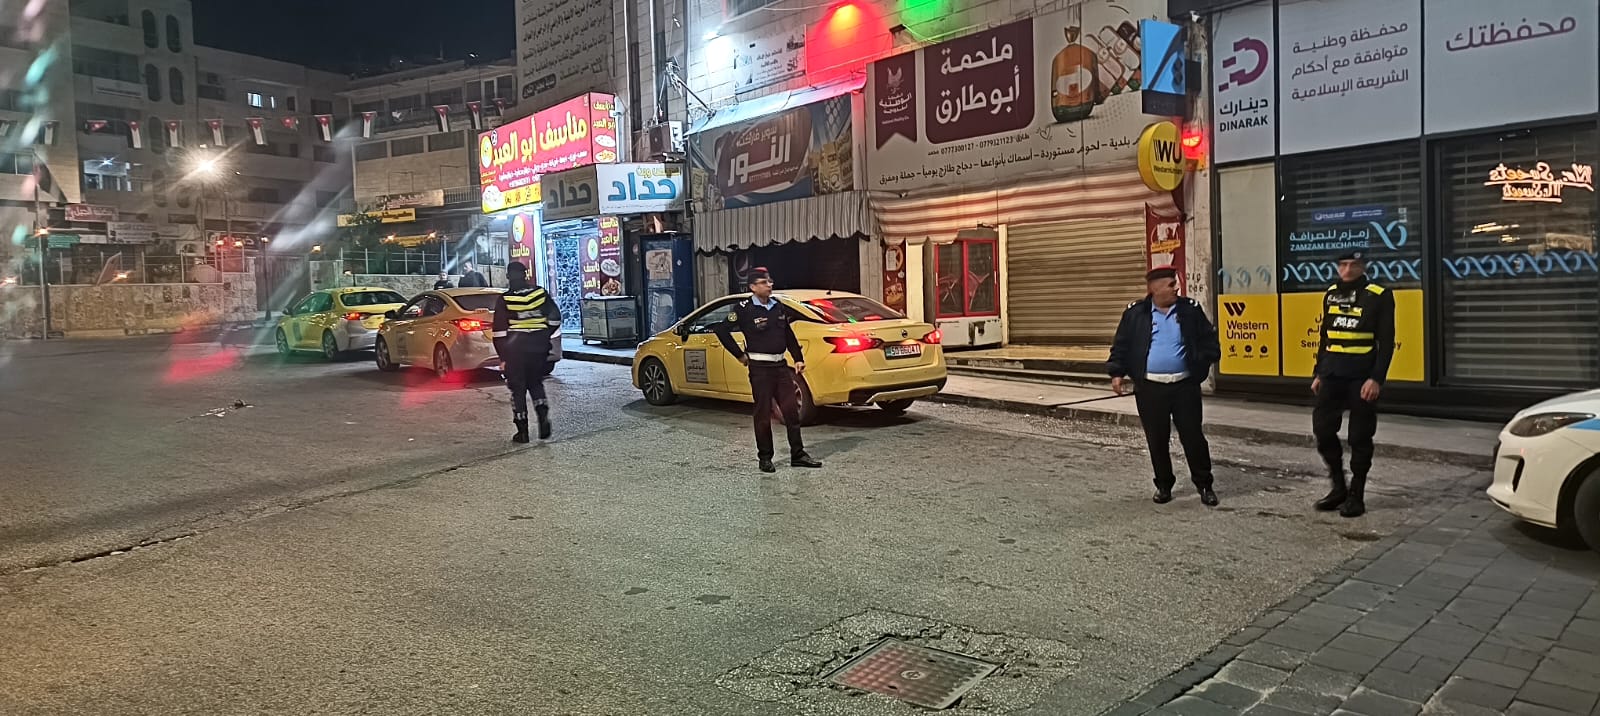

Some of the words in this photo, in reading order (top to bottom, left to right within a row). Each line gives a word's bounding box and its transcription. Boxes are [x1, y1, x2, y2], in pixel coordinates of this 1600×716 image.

[1351, 22, 1408, 42] محفظة
[1446, 16, 1576, 52] محفظتك
[1293, 35, 1347, 54] وطنية
[941, 37, 1013, 75] ملحمة
[1354, 47, 1408, 65] متوافقة
[1292, 55, 1328, 80] أحكام
[1331, 58, 1349, 75] مع
[1356, 69, 1409, 90] الشريعة
[1291, 79, 1353, 101] الإسلامية
[1219, 97, 1268, 117] دينارك
[540, 111, 587, 151] مناسف
[1219, 115, 1268, 132] DINARAK
[521, 116, 537, 163] أبو
[1109, 136, 1130, 151] بلدية
[493, 130, 518, 170] العبد
[1007, 147, 1032, 163] أسماك
[1041, 147, 1074, 161] مستوردة
[1155, 139, 1182, 164] WU
[728, 133, 791, 187] النور
[956, 162, 973, 175] دجاج
[980, 153, 1006, 168] بأنواعها
[547, 180, 592, 209] حداد
[608, 172, 676, 201] حداد
[1289, 229, 1336, 241] للصرافة
[1339, 228, 1370, 241] زمزم
[1290, 242, 1325, 251] ZAMZAM
[1325, 240, 1369, 250] EXCHANGE
[1226, 320, 1269, 330] Western
[1226, 330, 1257, 340] Union
